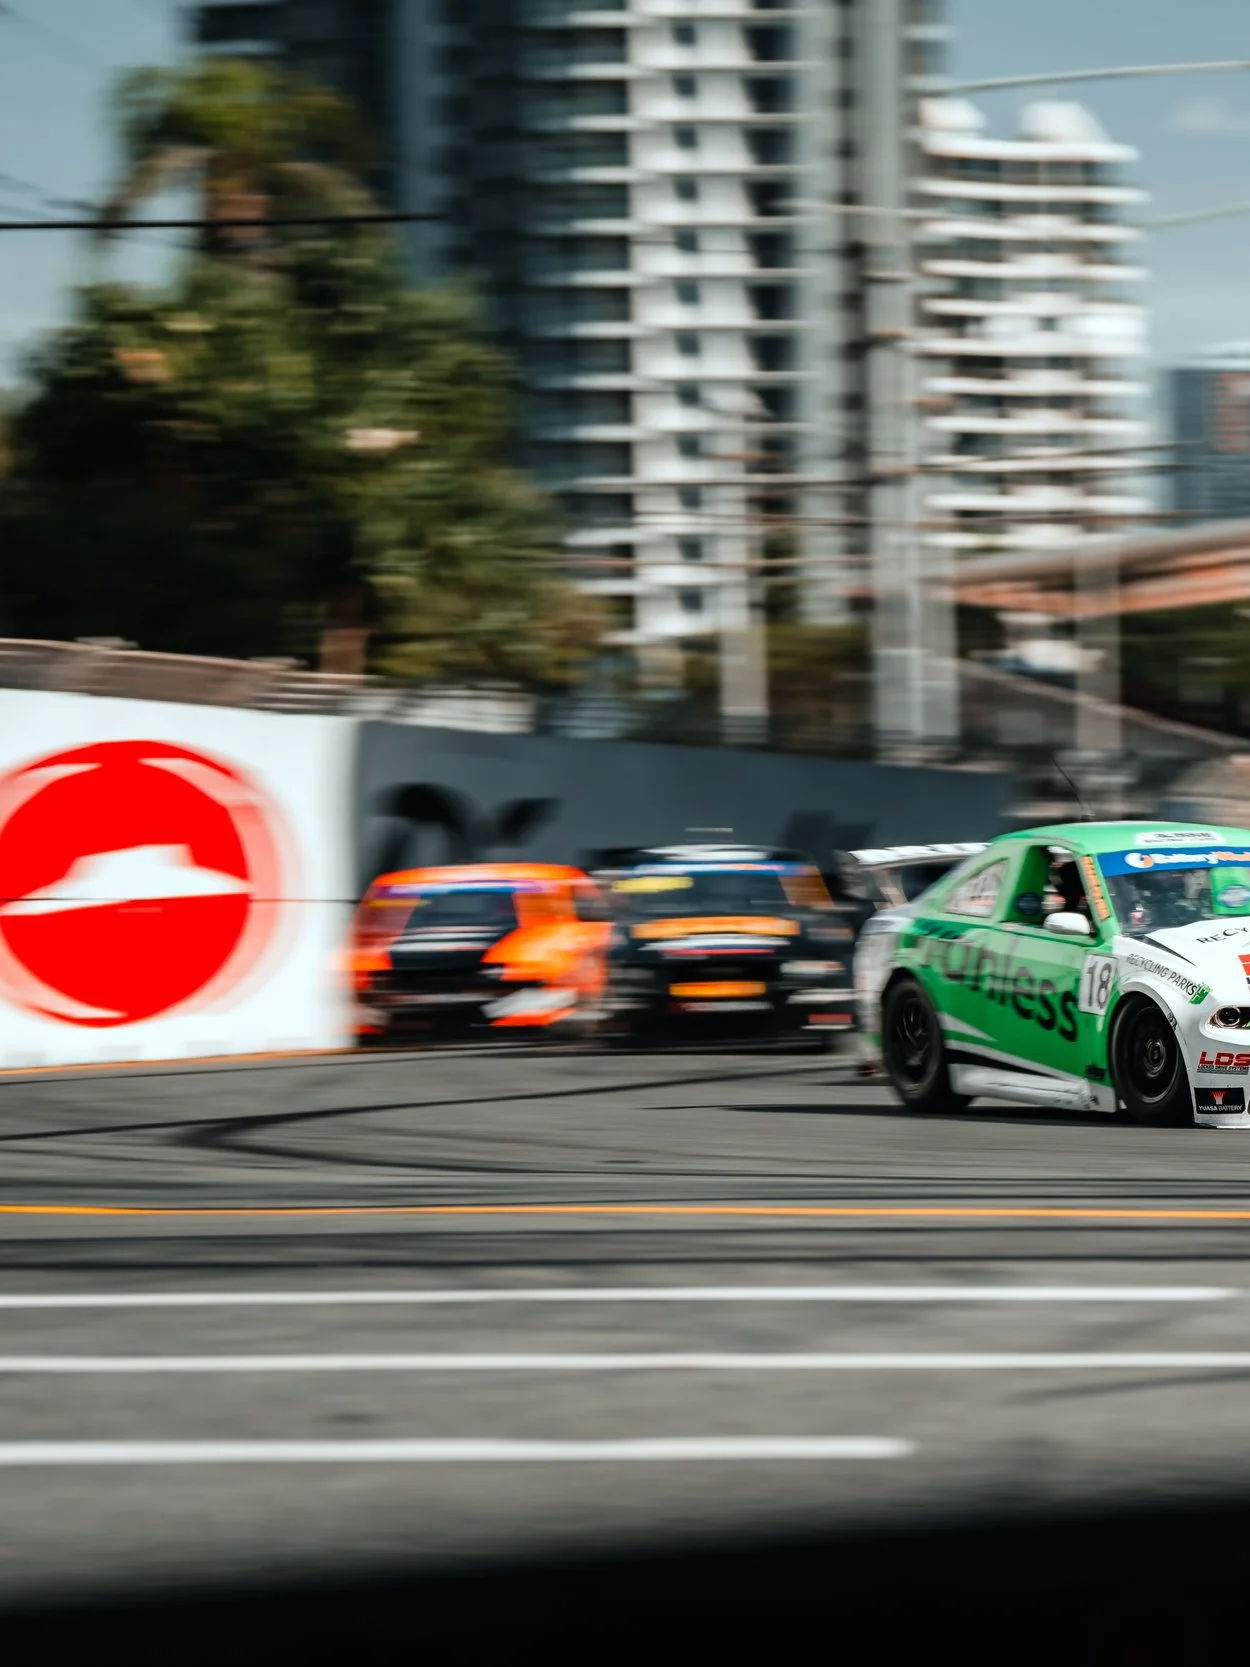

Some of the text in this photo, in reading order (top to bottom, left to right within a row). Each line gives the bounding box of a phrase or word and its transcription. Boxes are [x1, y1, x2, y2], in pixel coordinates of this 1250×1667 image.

[1126, 953, 1169, 979] RECYCLING
[1086, 960, 1112, 1010] 18
[1168, 968, 1198, 996] PARKS
